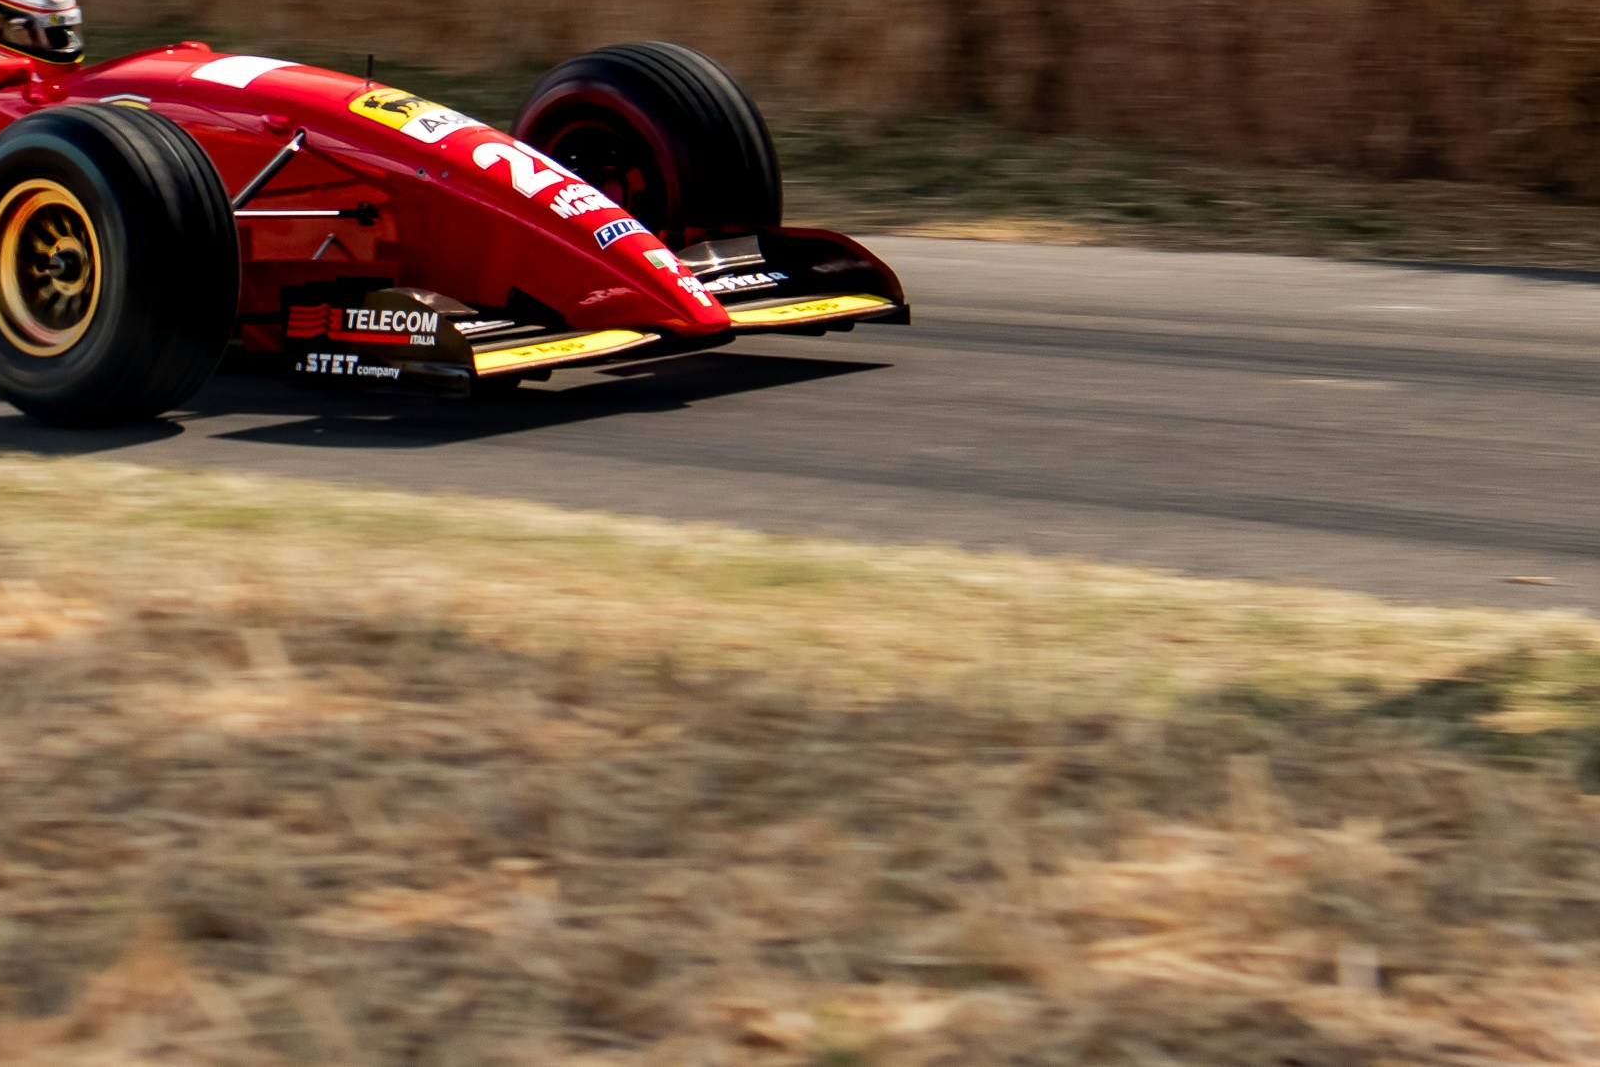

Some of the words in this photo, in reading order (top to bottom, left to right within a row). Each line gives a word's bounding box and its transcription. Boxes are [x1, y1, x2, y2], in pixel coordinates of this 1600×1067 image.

[473, 140, 585, 198] 2
[602, 220, 645, 243] FIA
[345, 308, 439, 333] TELECOM
[409, 335, 436, 346] ITALIA
[306, 352, 359, 375] STET
[357, 365, 400, 380] company
